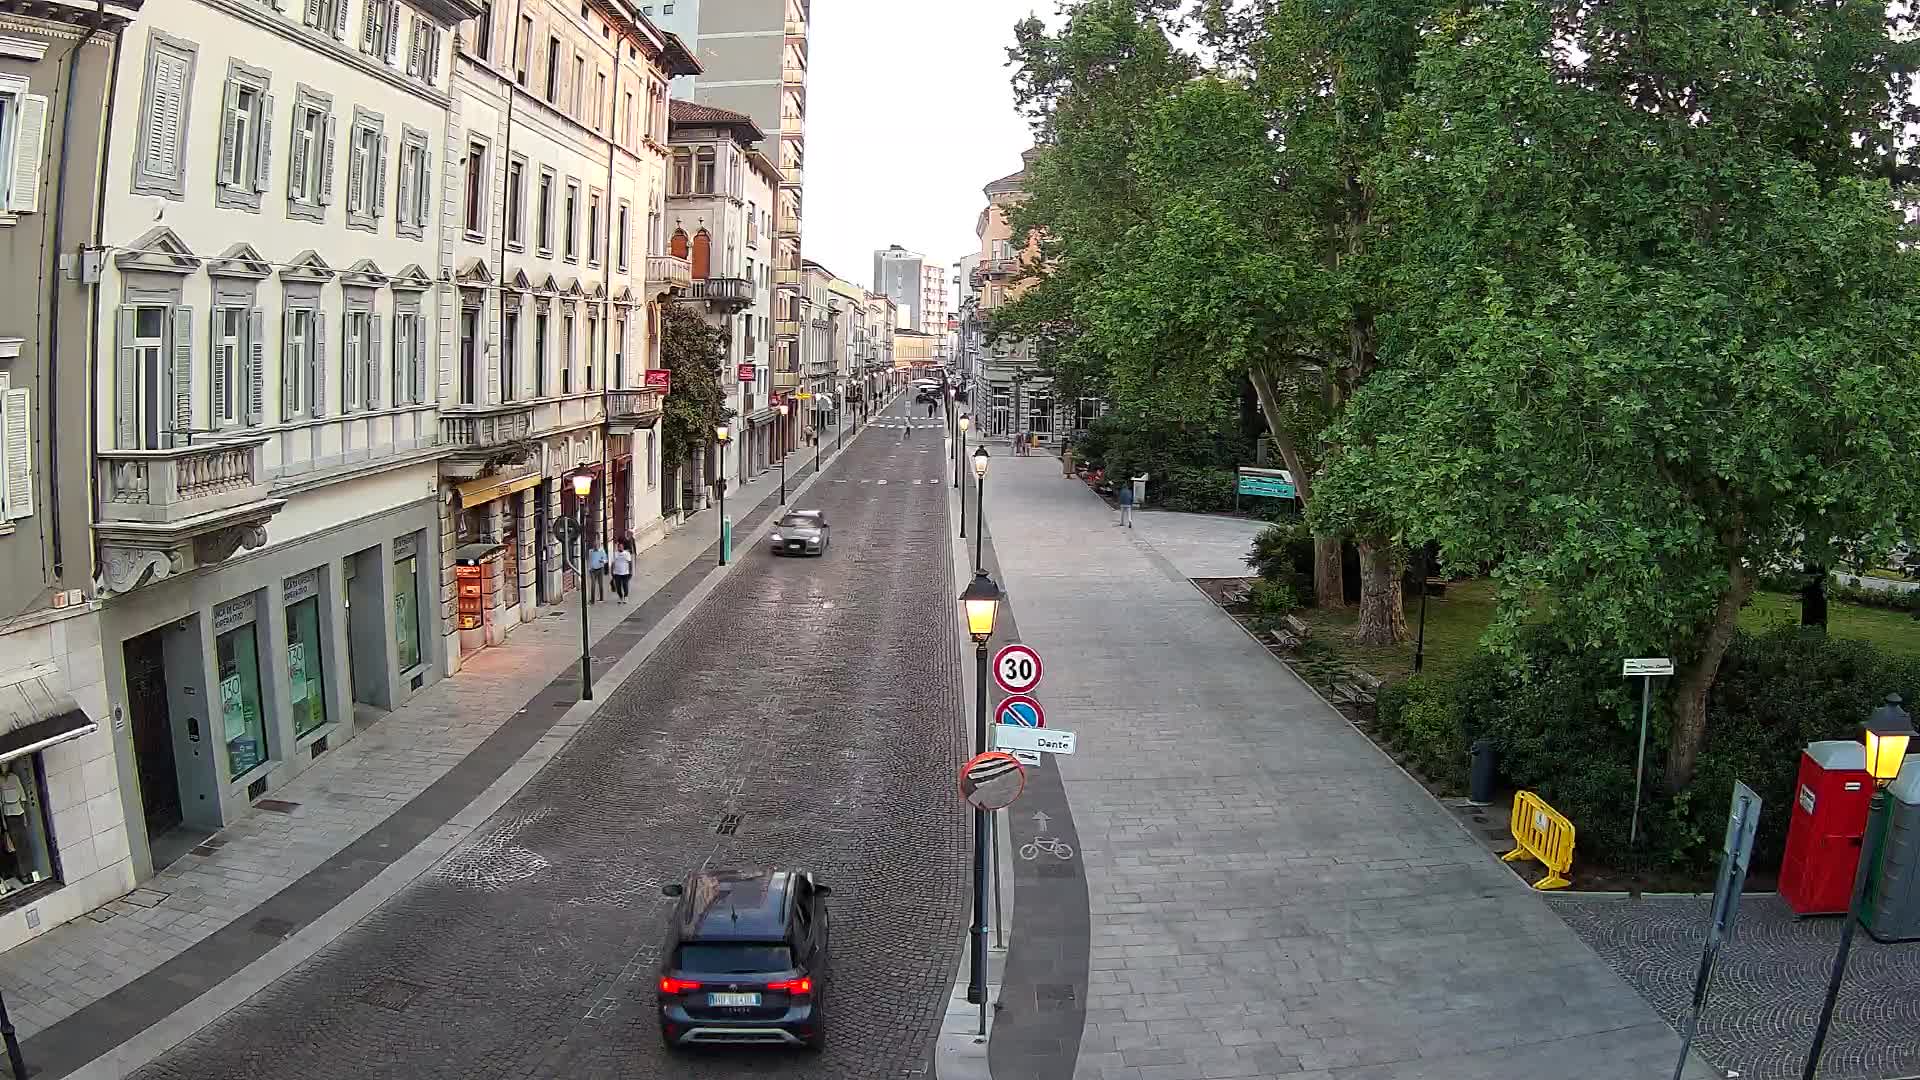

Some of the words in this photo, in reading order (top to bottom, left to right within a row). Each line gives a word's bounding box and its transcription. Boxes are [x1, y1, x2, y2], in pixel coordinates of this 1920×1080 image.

[1005, 658, 1032, 680] 30
[222, 678, 239, 700] 130
[1037, 738, 1069, 749] Dante
